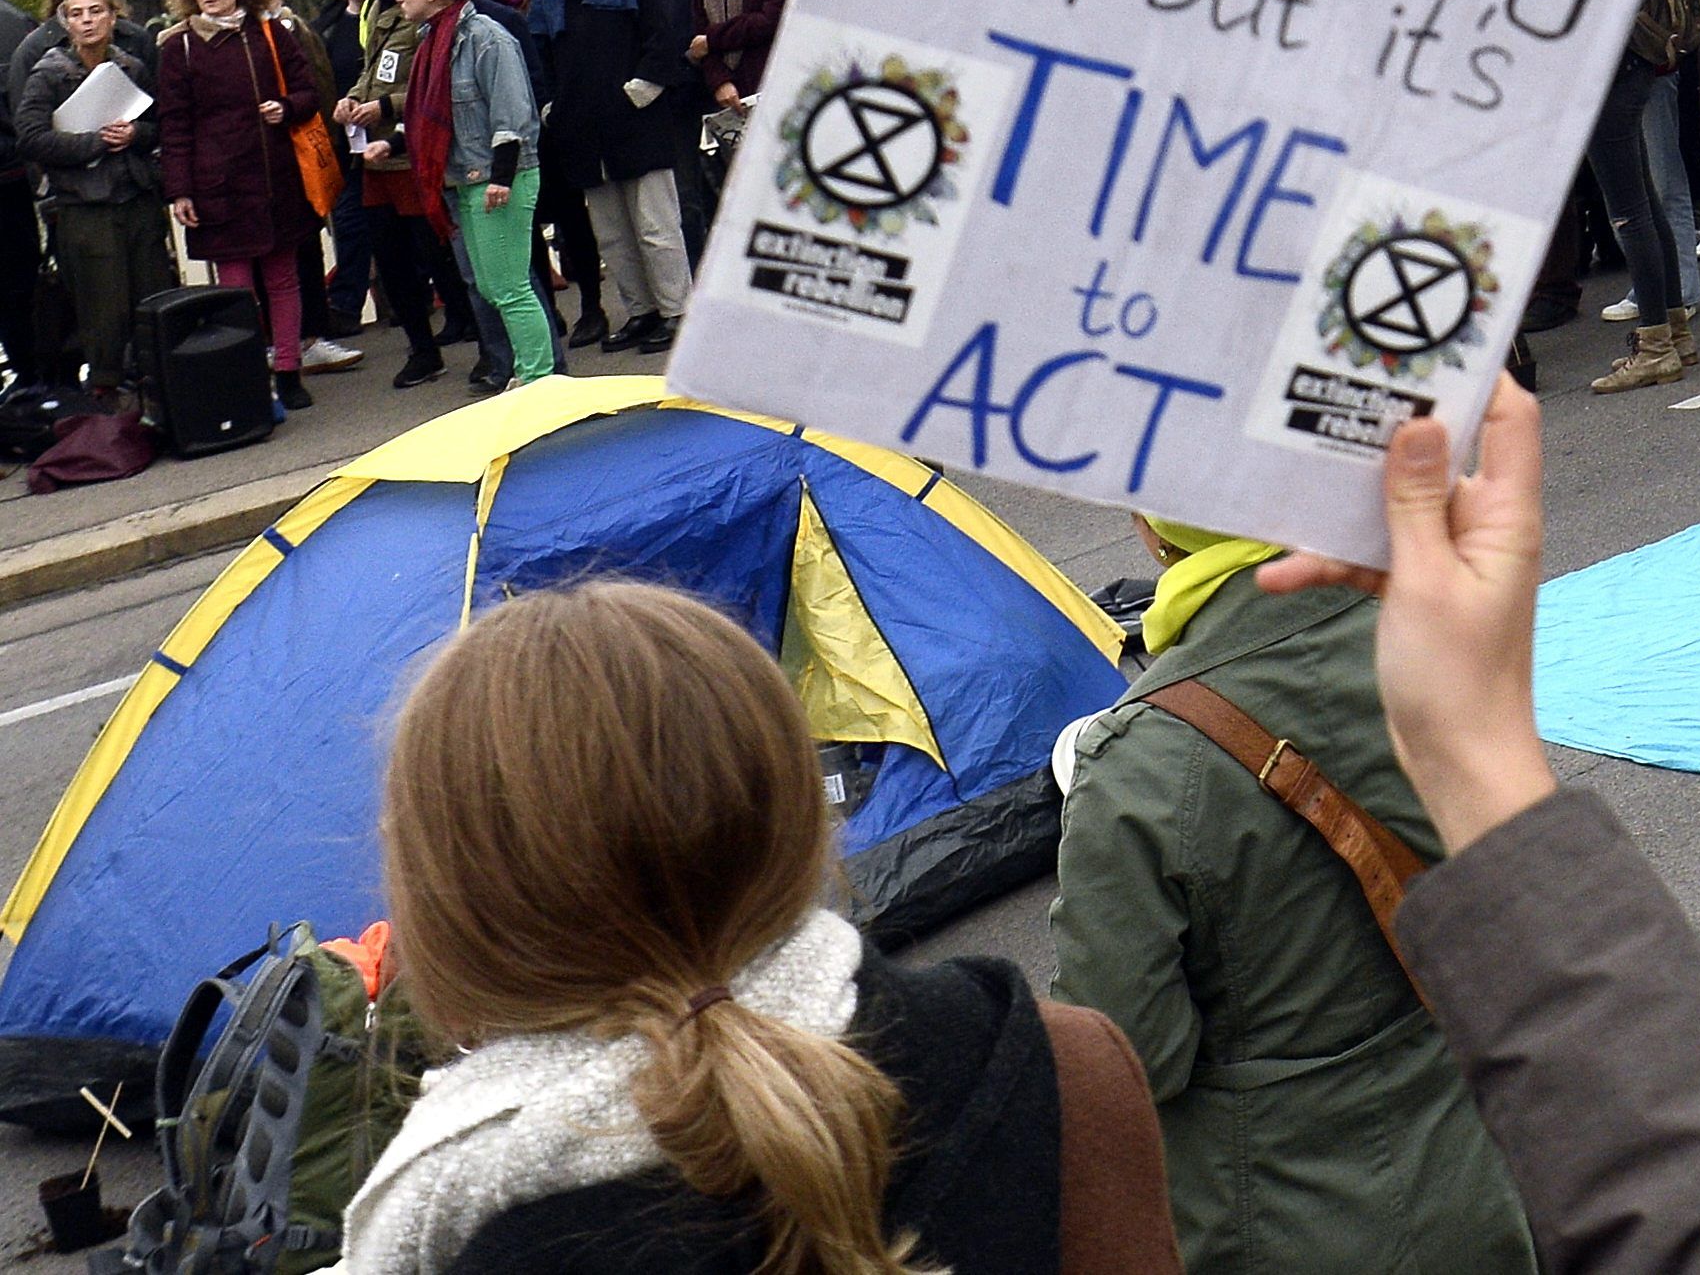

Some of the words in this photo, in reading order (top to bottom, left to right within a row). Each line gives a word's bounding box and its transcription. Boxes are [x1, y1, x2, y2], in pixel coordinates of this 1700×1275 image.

[985, 29, 1349, 287] TIME
[753, 227, 889, 276] extinction
[781, 269, 905, 318] rebellion
[1071, 257, 1160, 342] to
[900, 318, 1228, 497] ACT
